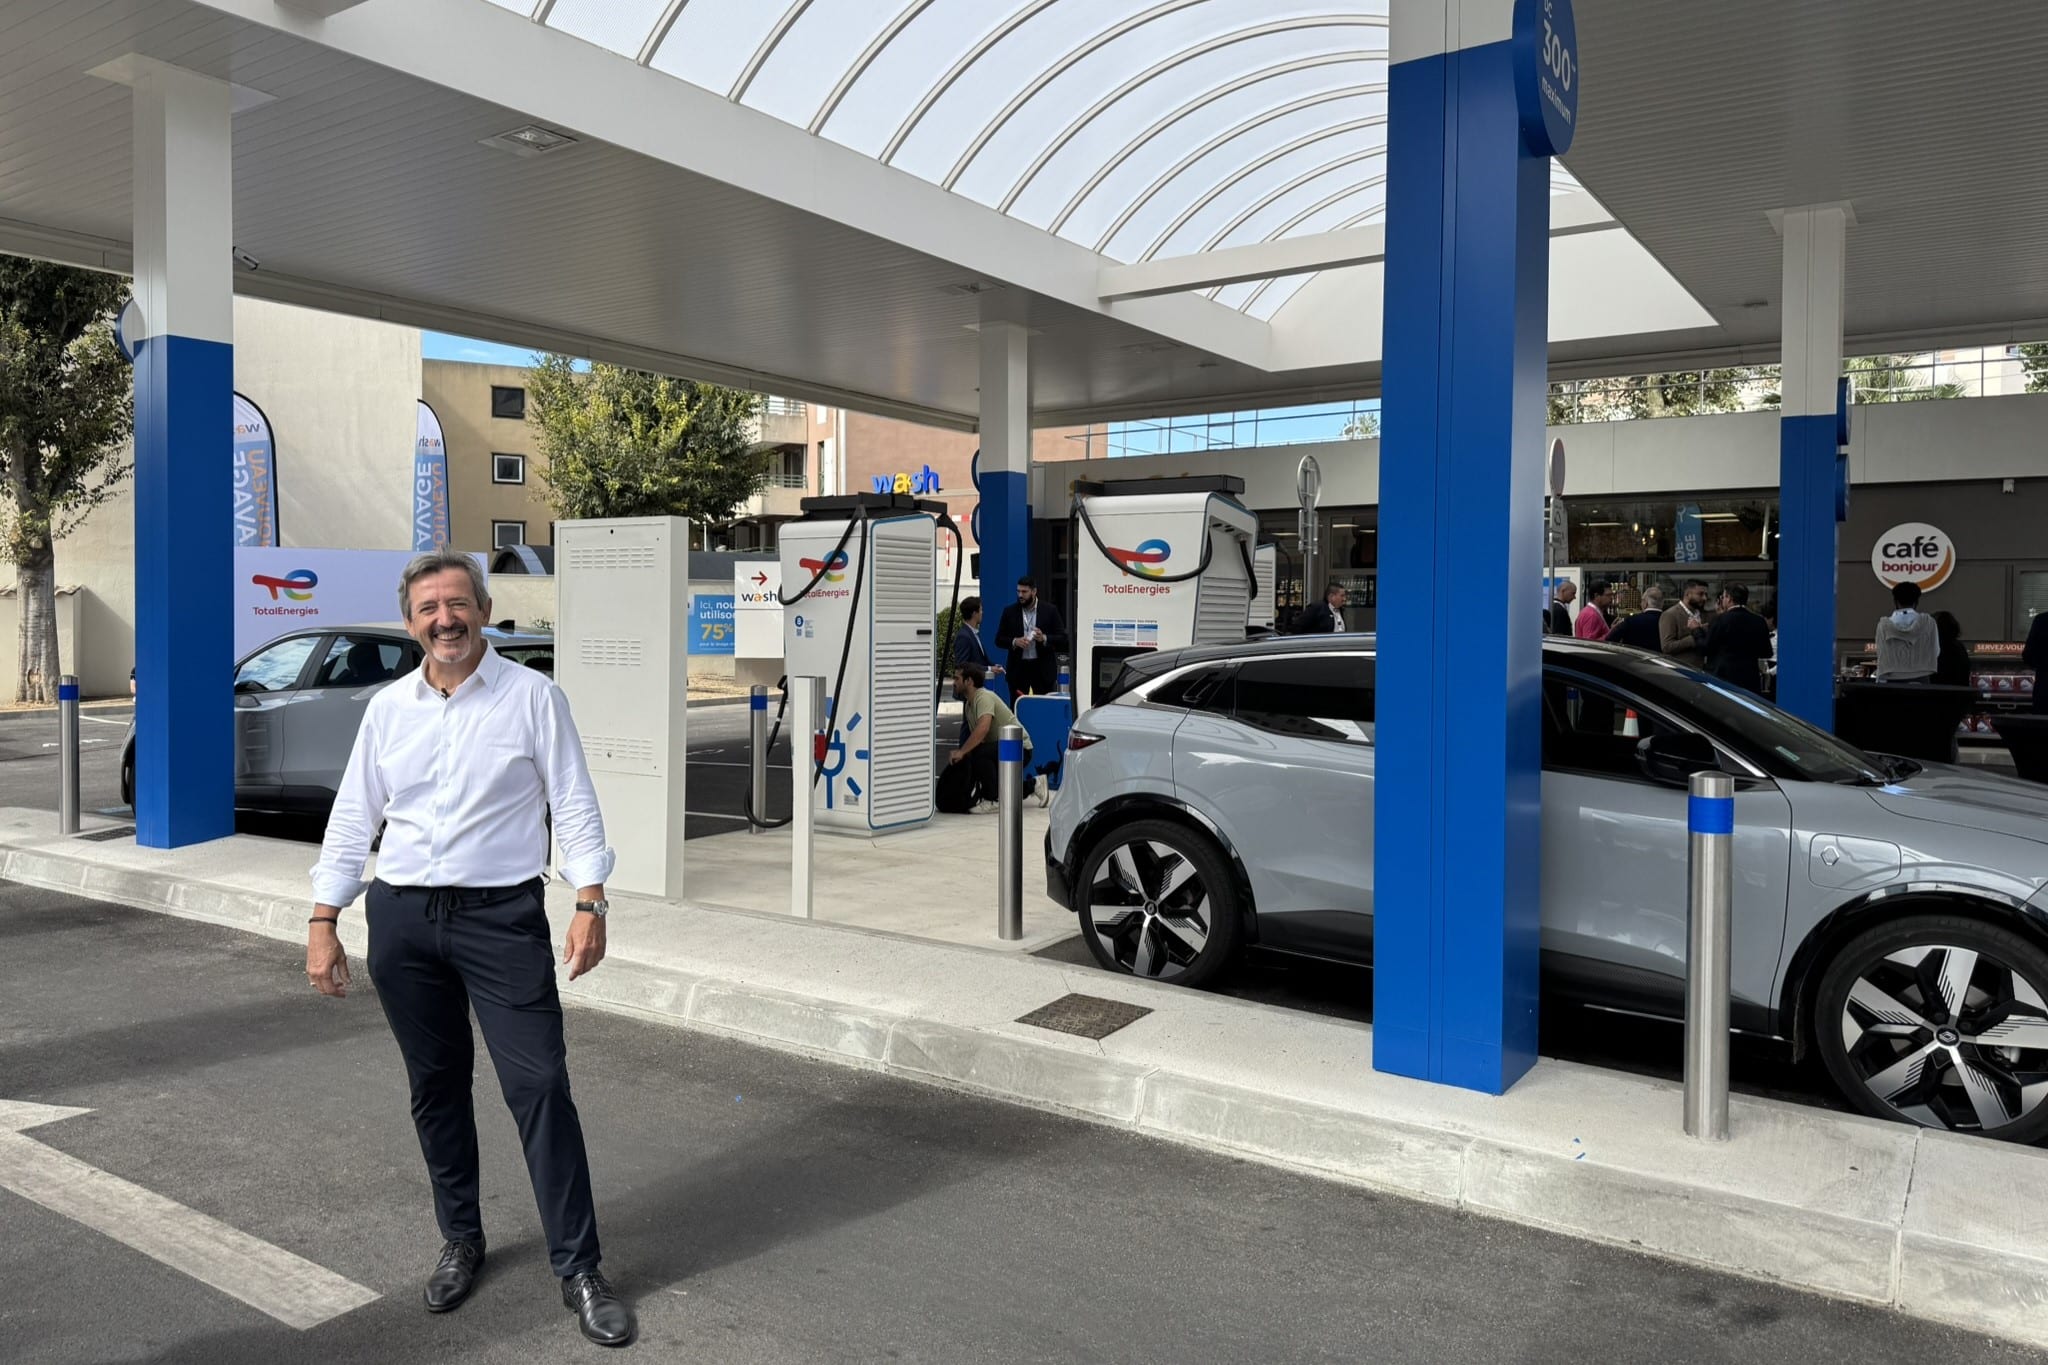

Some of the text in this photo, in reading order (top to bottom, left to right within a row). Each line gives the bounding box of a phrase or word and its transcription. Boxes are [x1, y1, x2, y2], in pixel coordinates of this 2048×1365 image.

[1543, 18, 1571, 92] 300
[1541, 75, 1571, 126] maximum
[872, 464, 939, 495] wash
[1882, 535, 1939, 558] café
[1881, 560, 1939, 575] bonjour
[741, 590, 777, 602] wash
[804, 587, 850, 599] talEnergies
[1103, 583, 1171, 596] TotalEnergies
[252, 606, 319, 617] TotalEnergies
[716, 601, 735, 609] nou
[700, 609, 735, 620] utiliso
